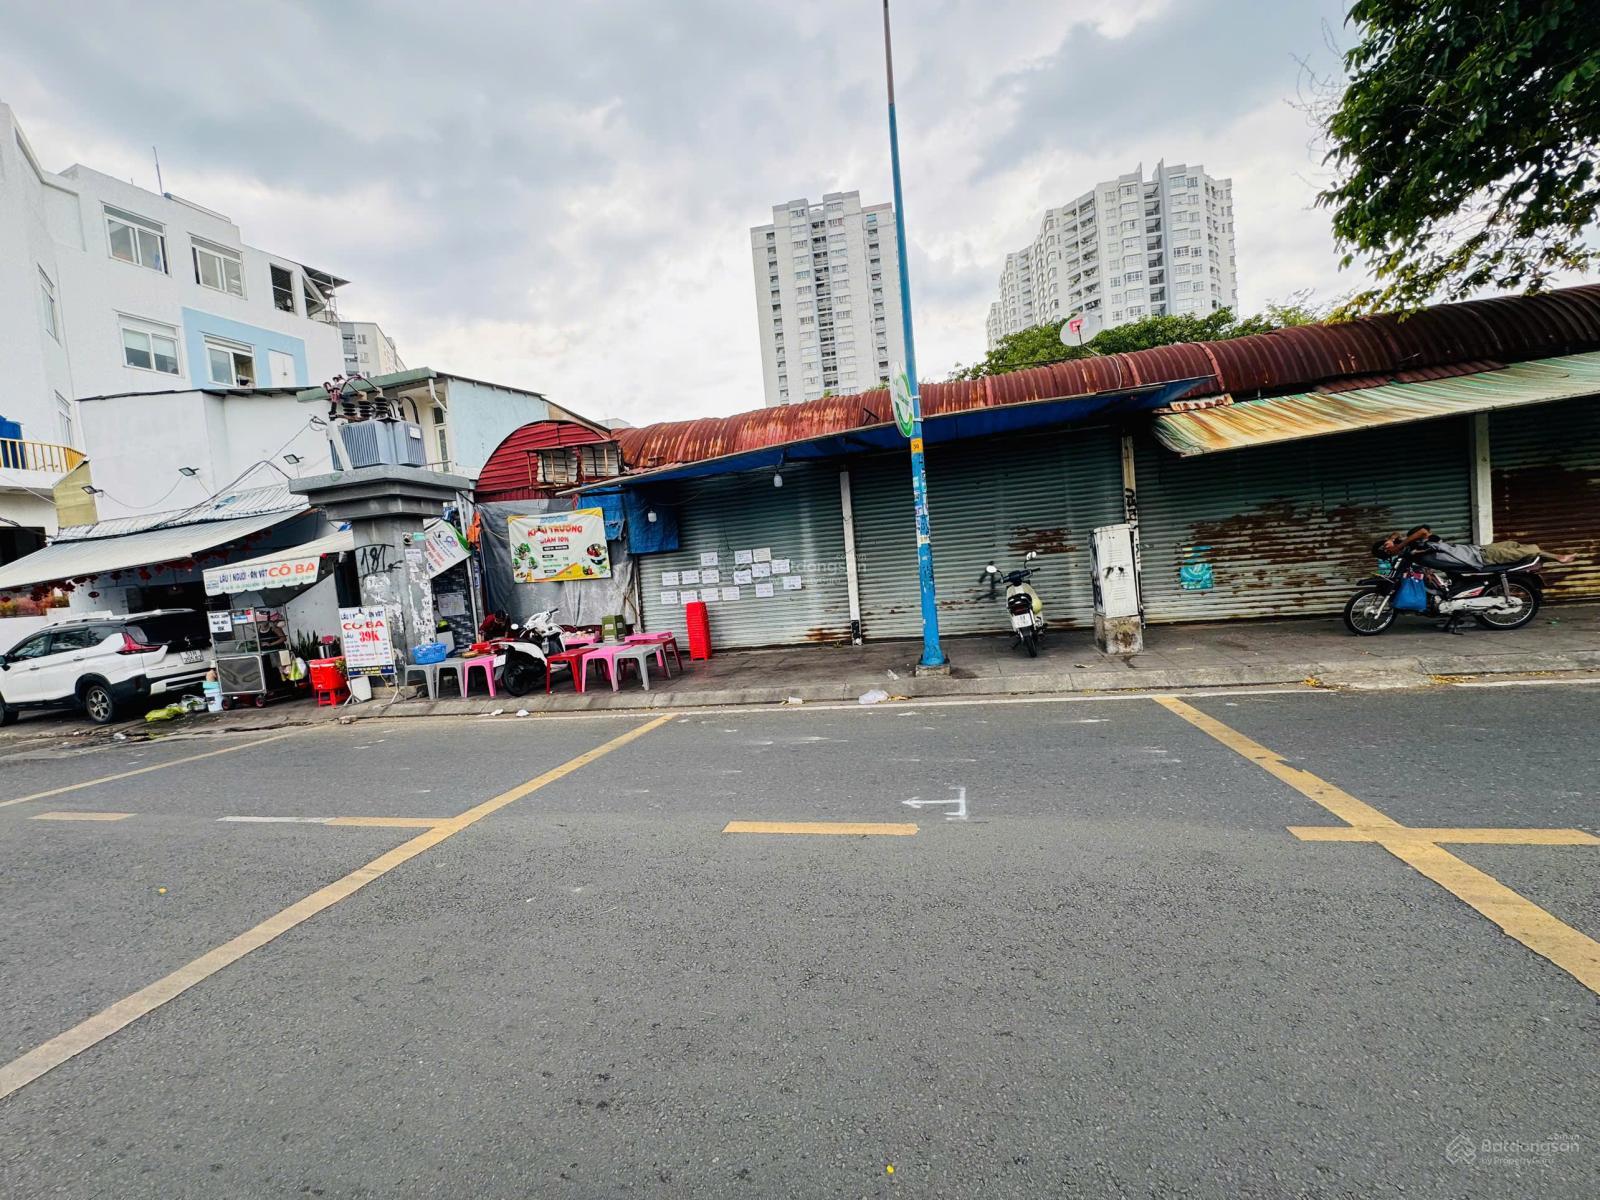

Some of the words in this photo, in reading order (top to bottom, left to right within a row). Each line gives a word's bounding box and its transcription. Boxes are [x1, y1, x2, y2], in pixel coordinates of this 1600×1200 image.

[268, 563, 291, 577] CÔ
[295, 562, 315, 574] BA
[365, 620, 385, 629] BA
[359, 630, 380, 643] 39K
